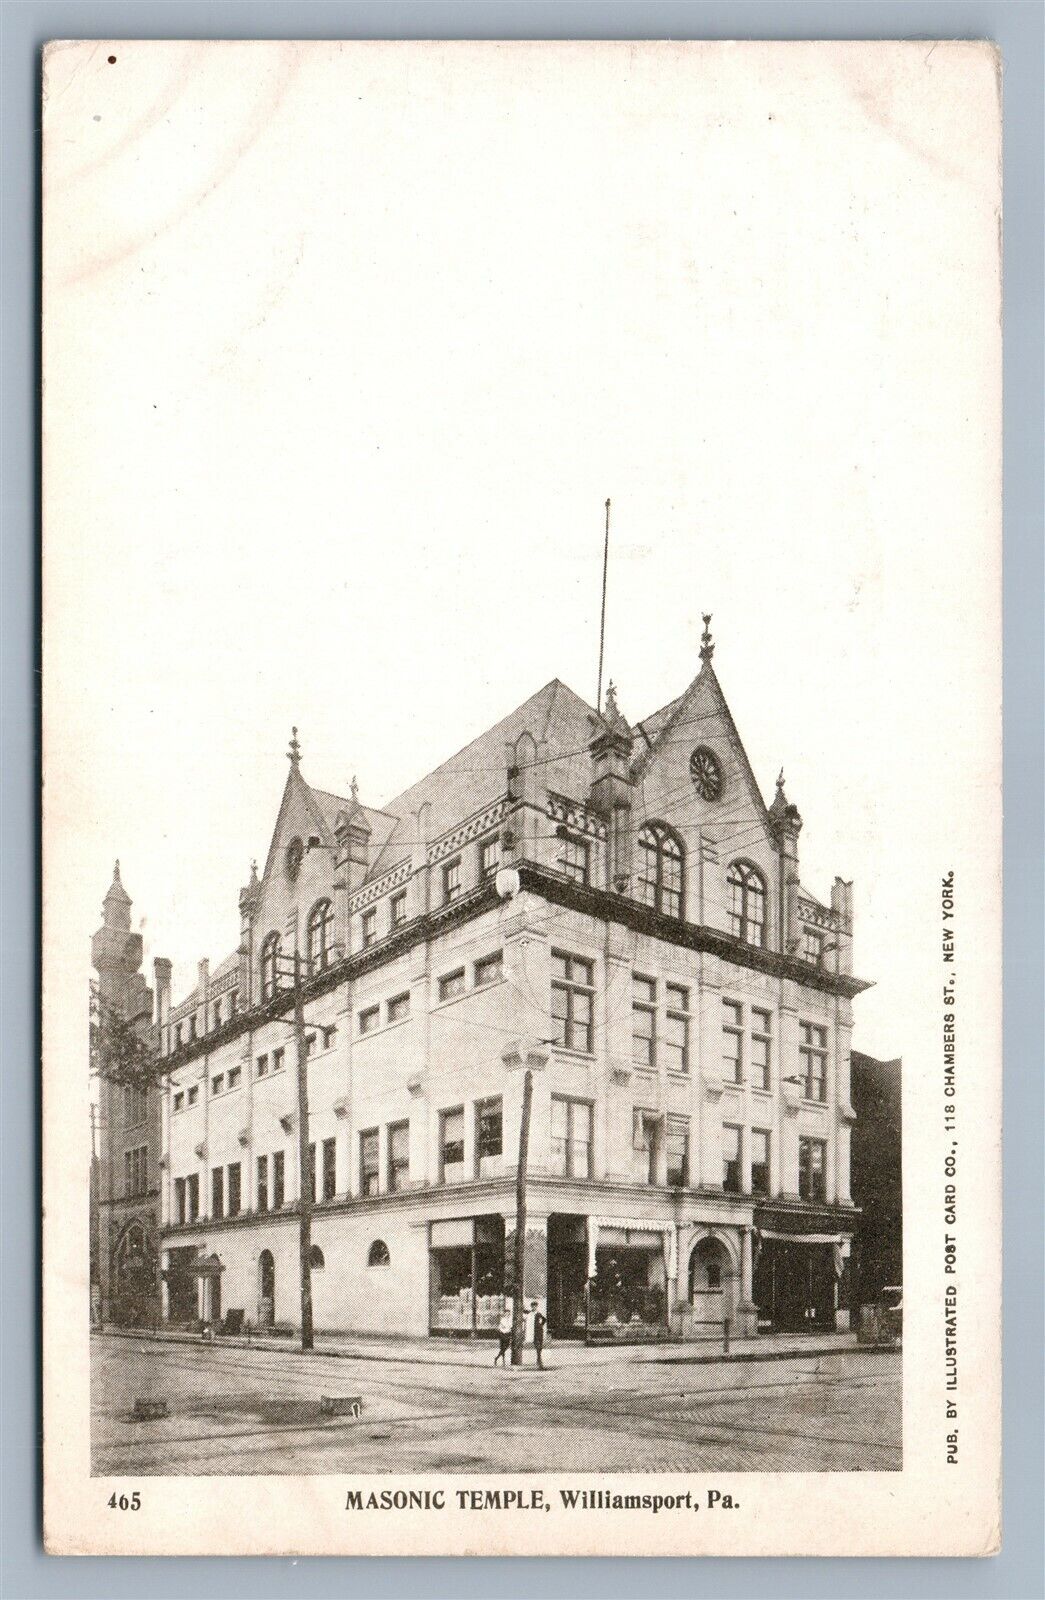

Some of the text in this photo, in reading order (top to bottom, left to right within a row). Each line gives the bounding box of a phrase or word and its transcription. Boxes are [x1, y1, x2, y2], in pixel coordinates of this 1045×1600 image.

[941, 870, 959, 1464] PUB. BY ILLUSTRATED POST CARD CO., 118 CHAMBERS ST., NEW YORK.
[107, 1491, 141, 1511] 465
[345, 1490, 740, 1514] MASONIC TEMPLE, Williamsport, Pa.
